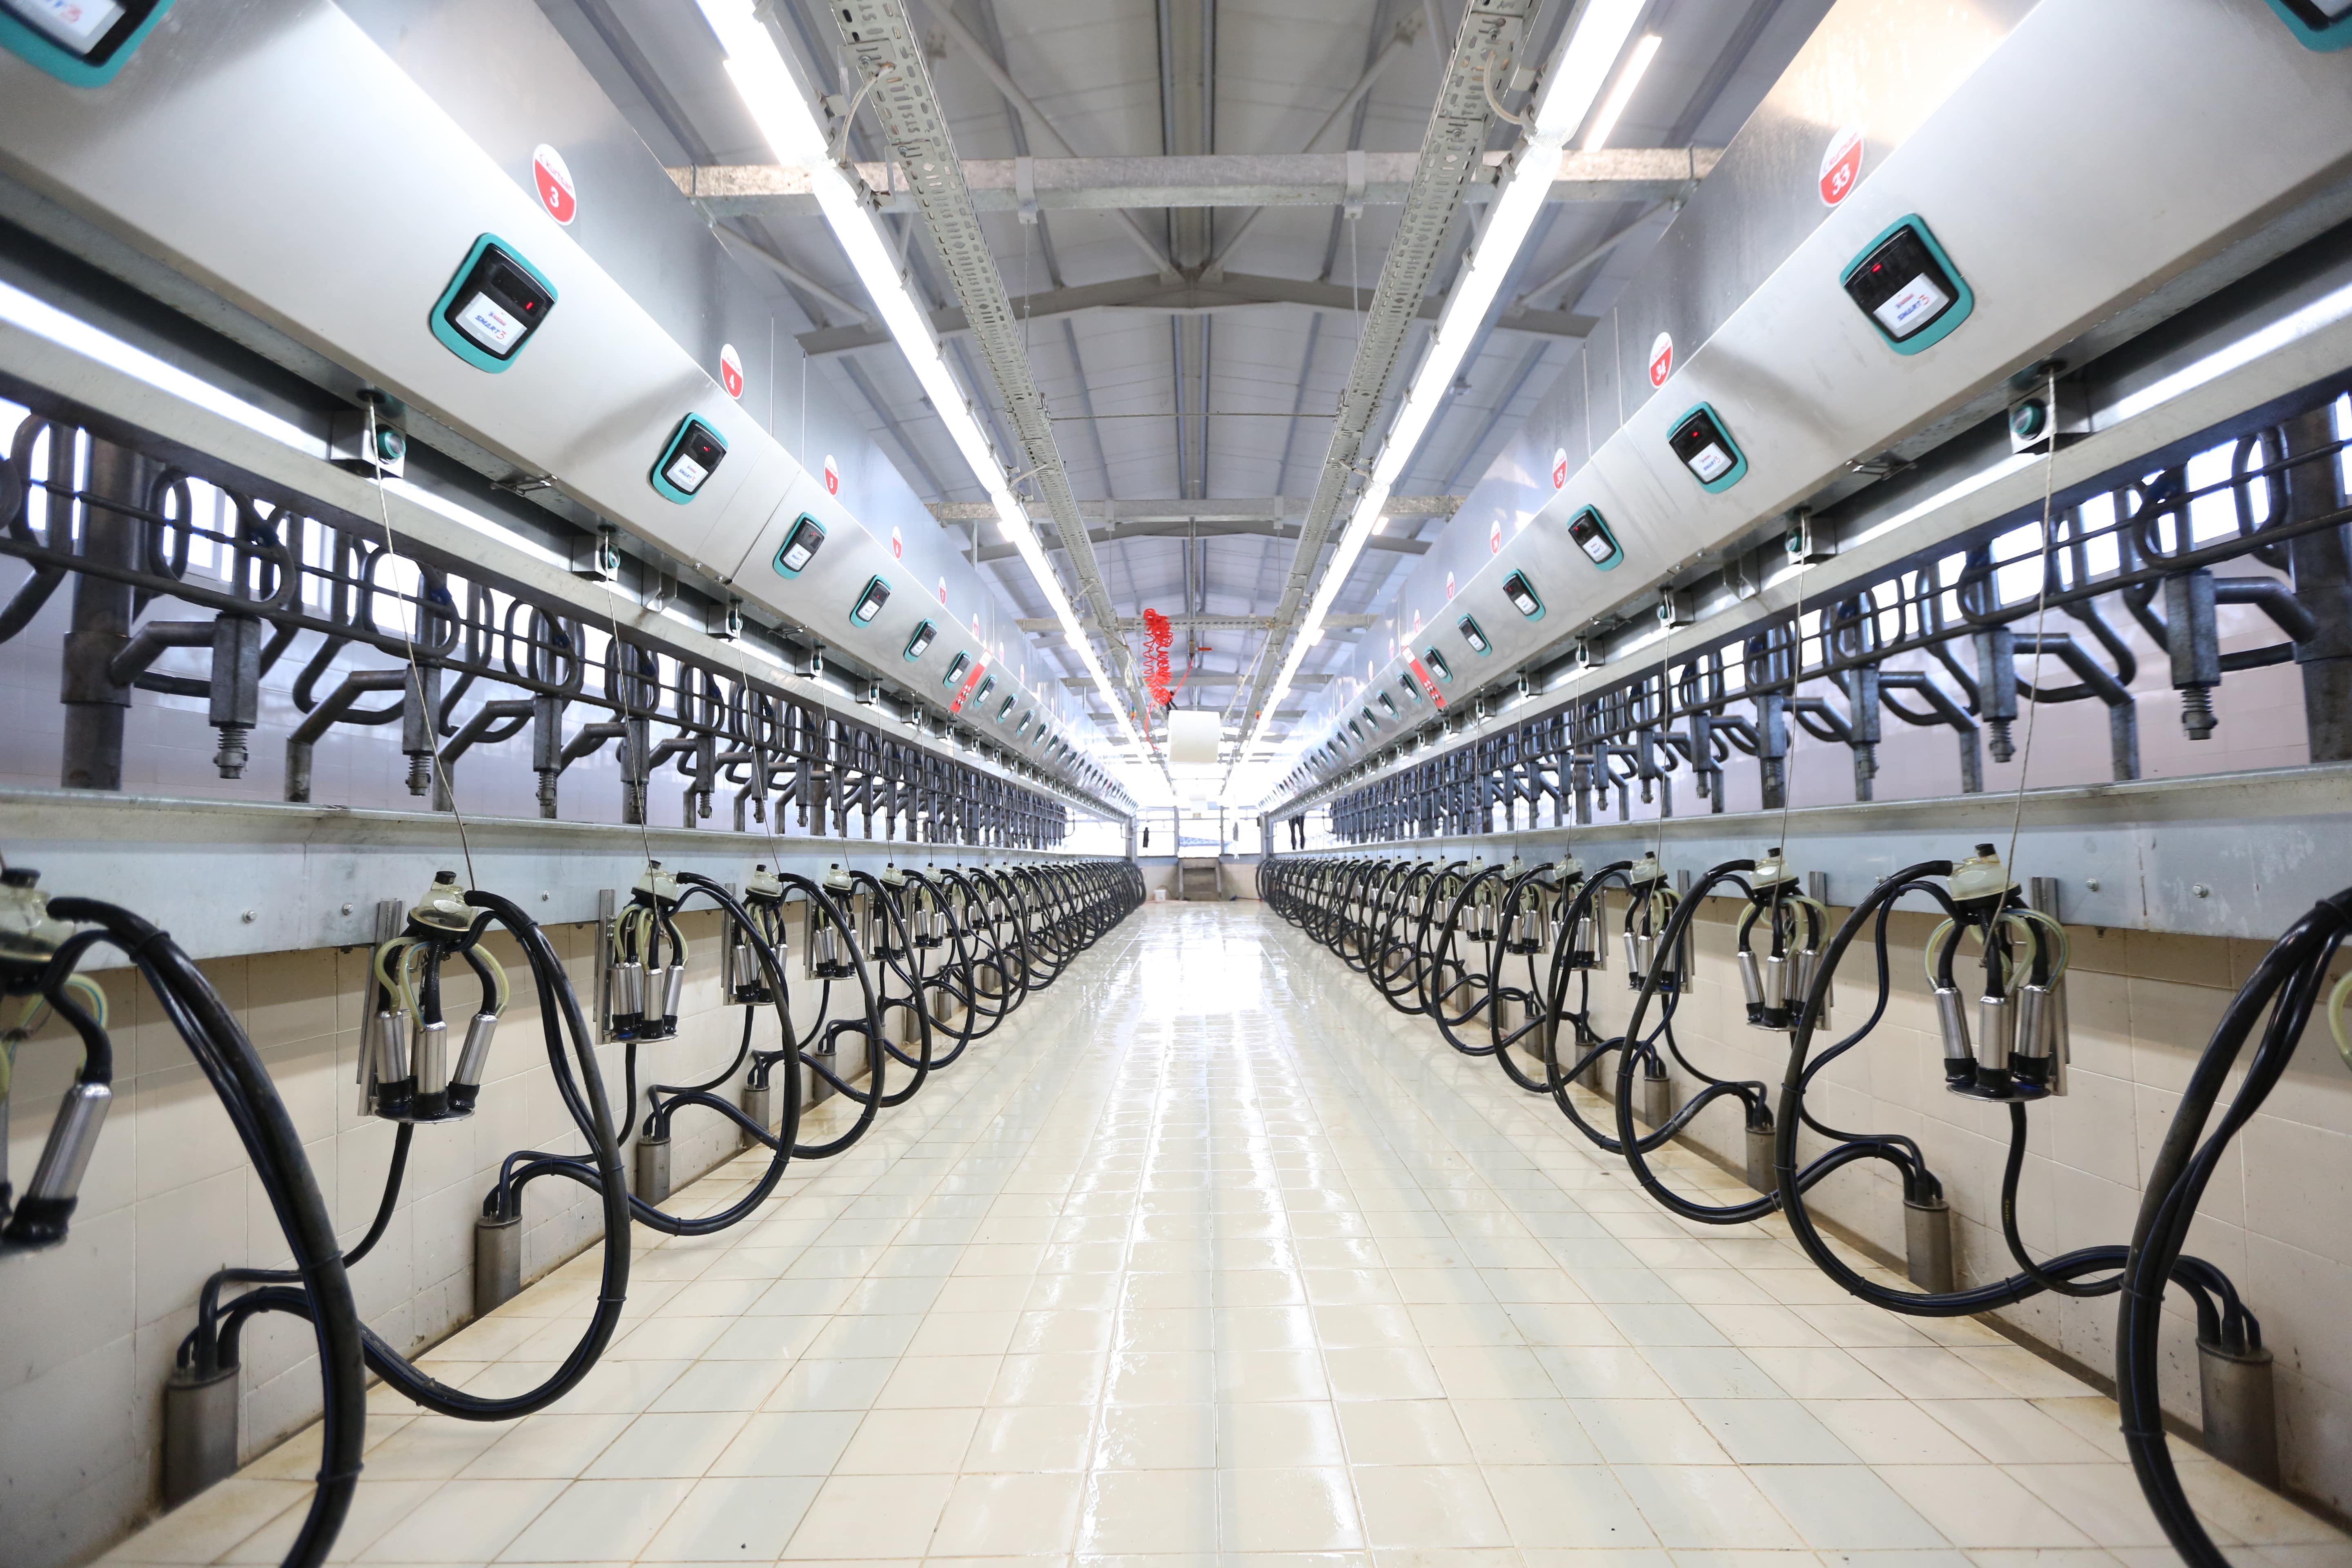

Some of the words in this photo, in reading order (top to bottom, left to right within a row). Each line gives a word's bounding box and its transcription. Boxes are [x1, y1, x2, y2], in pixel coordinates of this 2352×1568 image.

[1832, 163, 1851, 196] 33
[550, 185, 559, 208] 3
[1656, 359, 1667, 381] 34
[729, 374, 735, 390] 4
[830, 476, 834, 490] 5
[1557, 468, 1564, 486] 35
